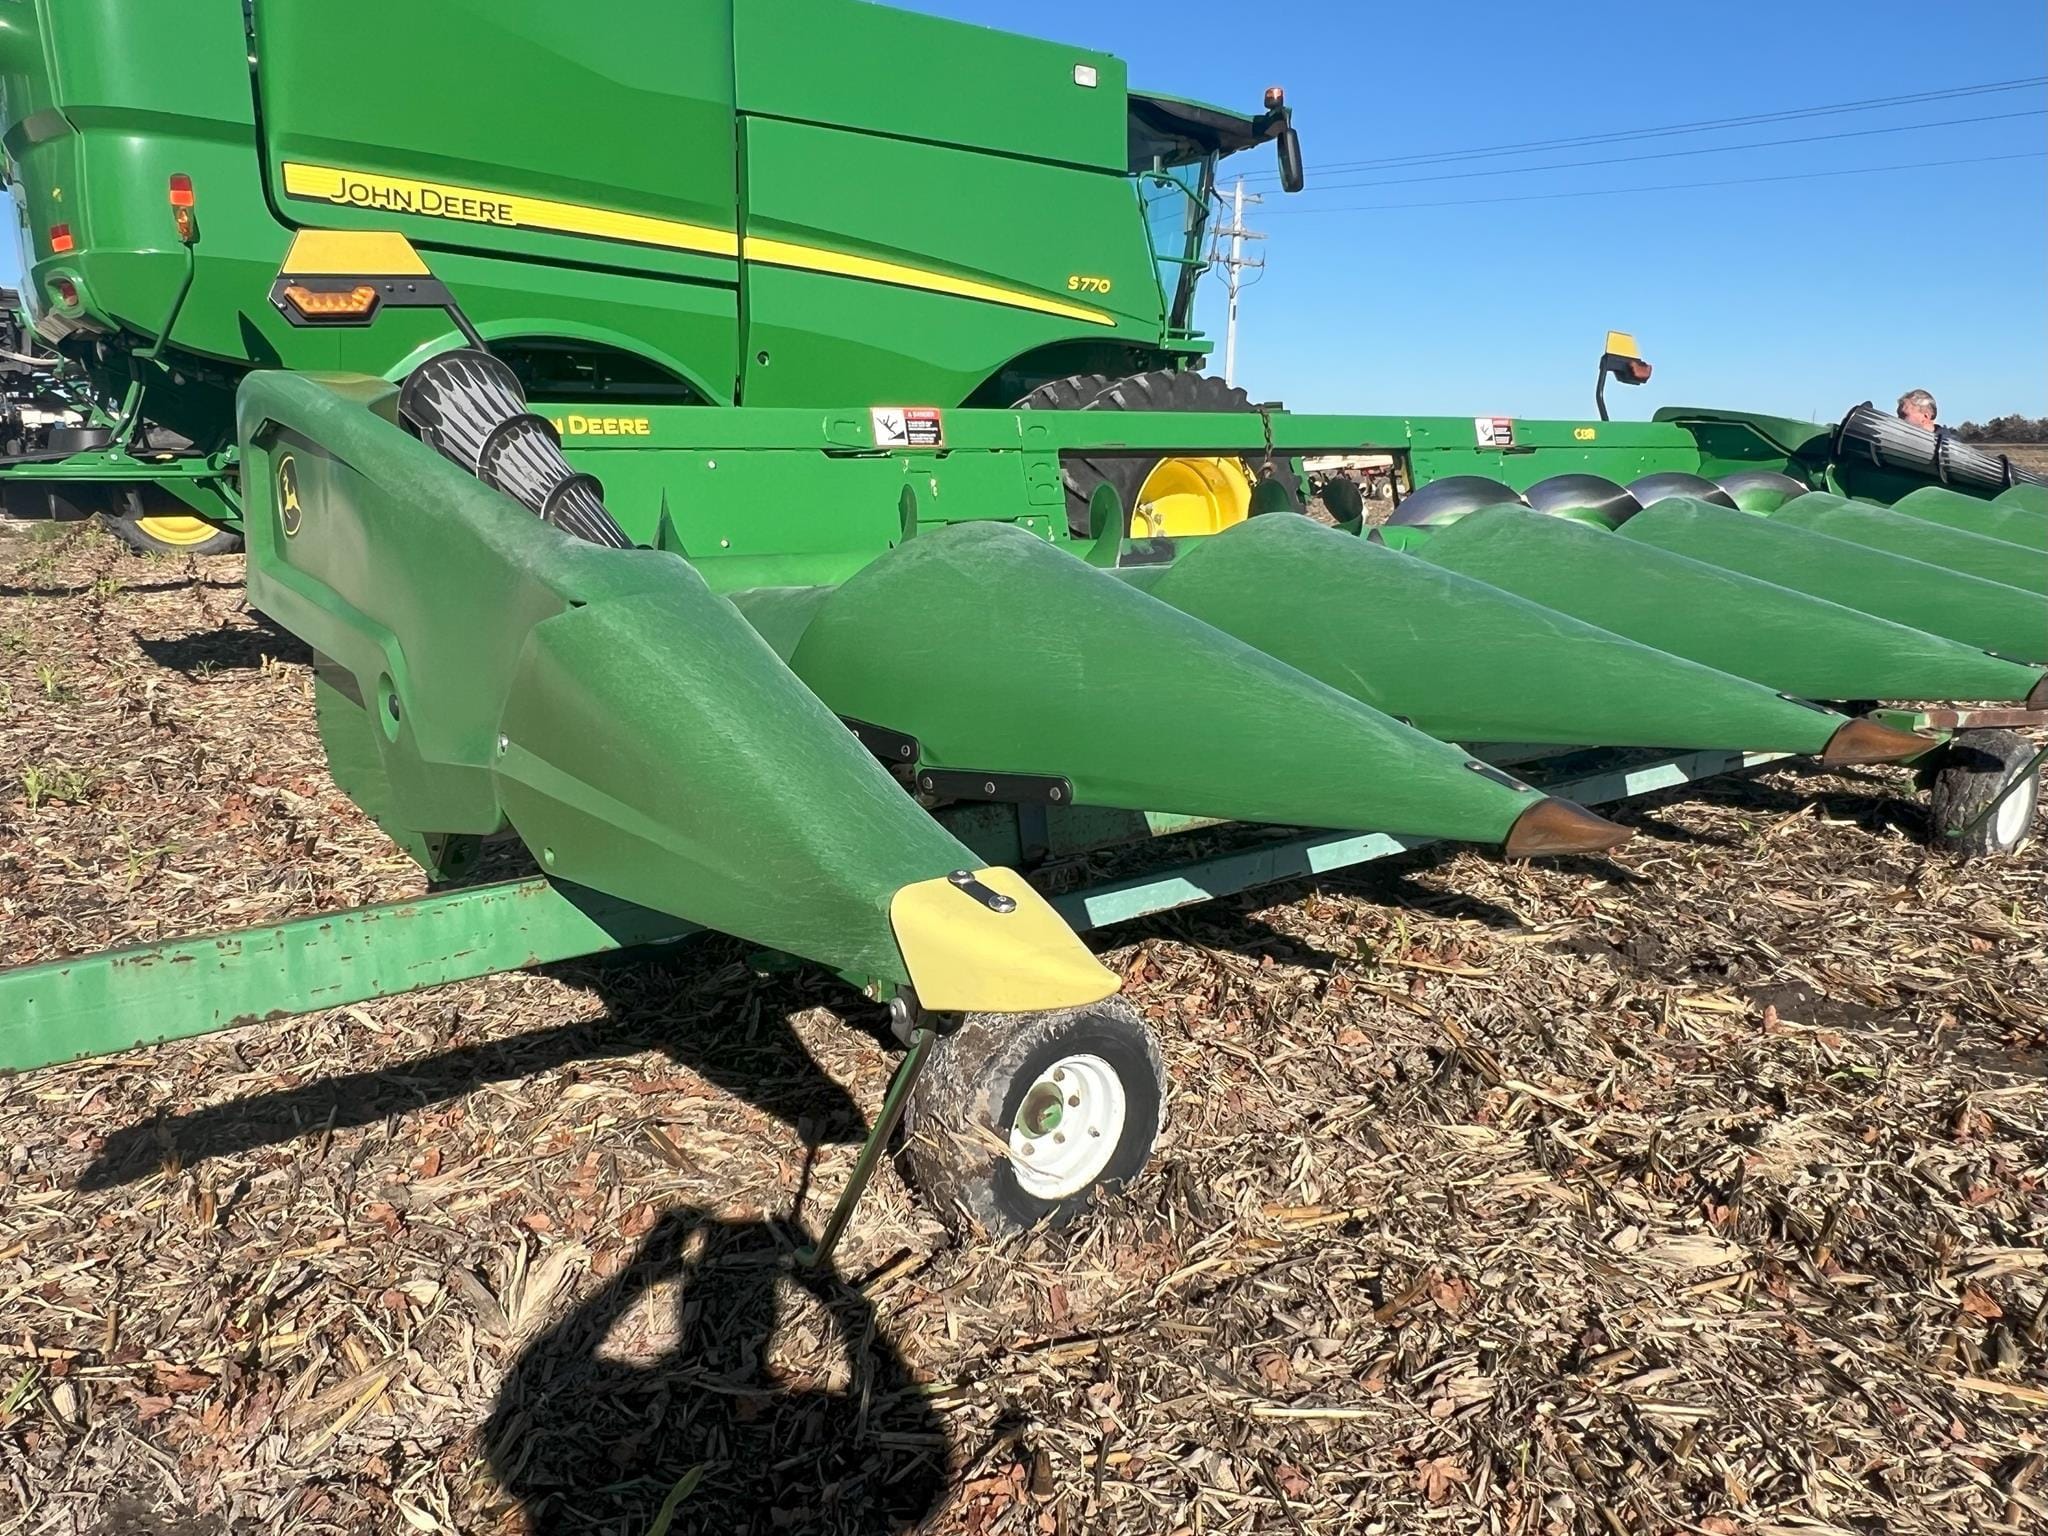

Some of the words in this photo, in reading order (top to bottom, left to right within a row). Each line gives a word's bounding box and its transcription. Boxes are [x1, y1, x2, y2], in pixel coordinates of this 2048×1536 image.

[330, 177, 411, 209] JOHN
[421, 189, 514, 222] DEERE
[1068, 276, 1111, 294] S770
[568, 415, 651, 435] DEERE
